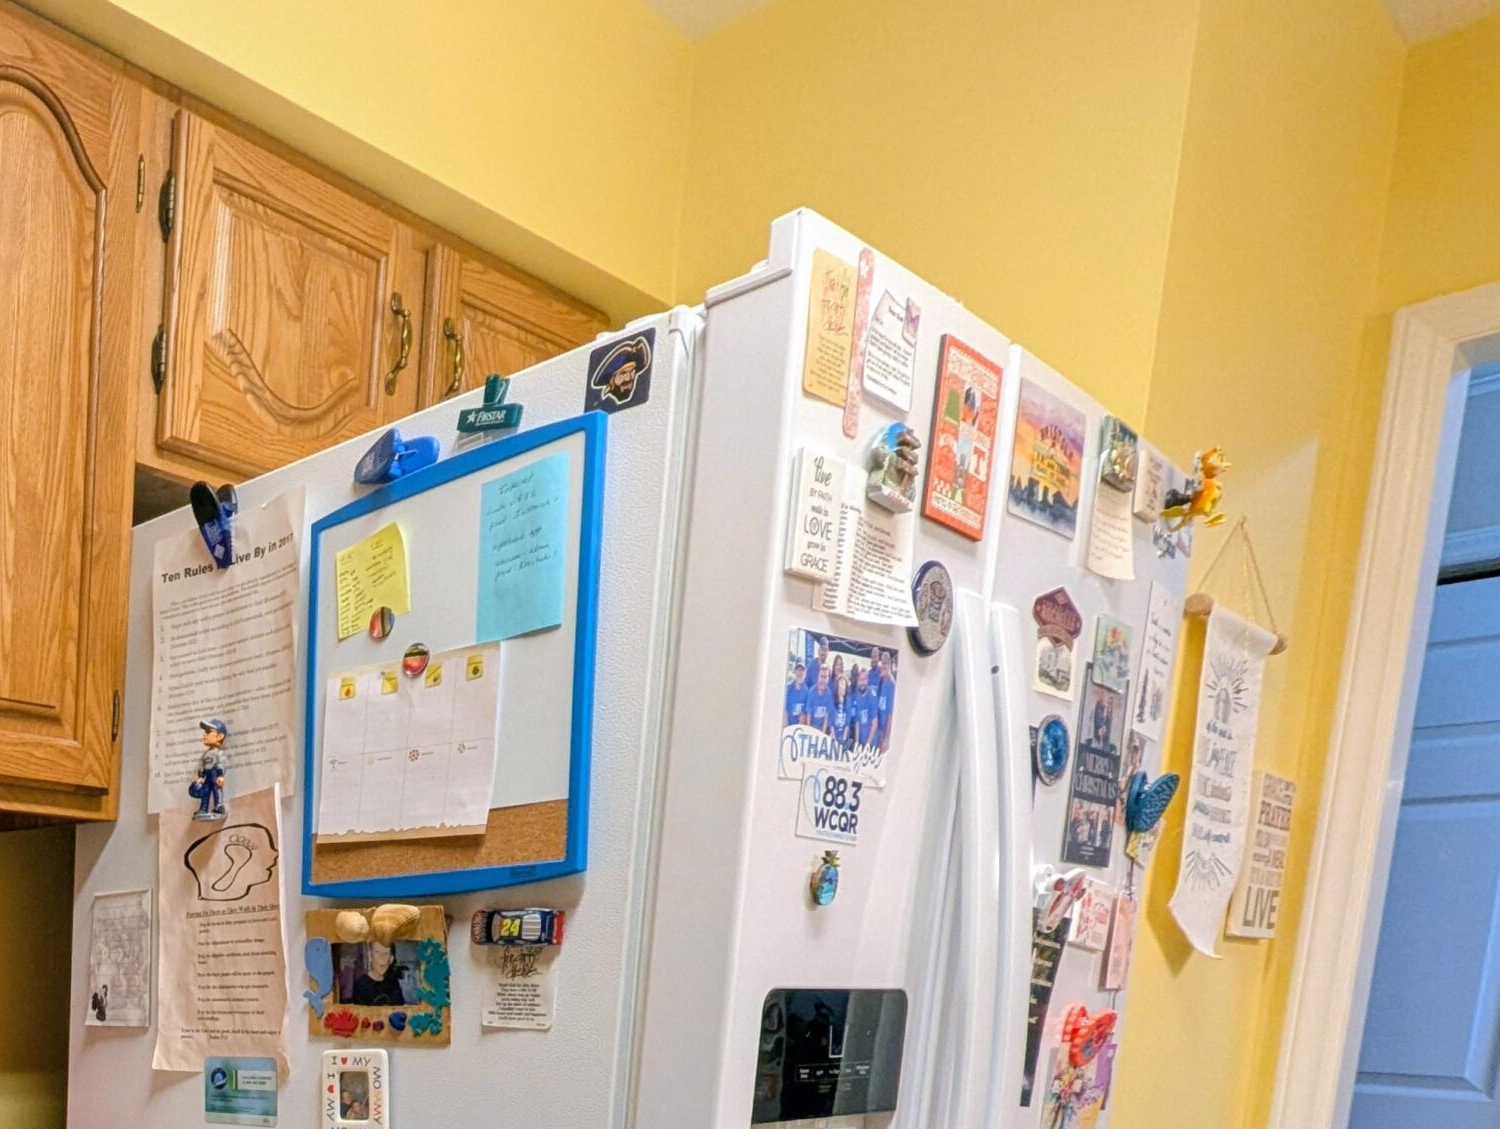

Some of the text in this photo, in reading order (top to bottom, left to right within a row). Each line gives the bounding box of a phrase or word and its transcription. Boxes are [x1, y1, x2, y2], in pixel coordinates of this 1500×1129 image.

[804, 514, 833, 541] LOVE
[161, 572, 181, 584] Ten
[184, 563, 214, 579] Rules
[254, 546, 265, 560] By
[268, 541, 277, 552] in
[278, 532, 294, 549] 2017
[800, 553, 829, 573] GRACE
[798, 733, 883, 775] THANK you
[822, 776, 863, 812] 88.3
[814, 805, 859, 835] WCQR
[1242, 885, 1280, 930] LIVE
[499, 918, 521, 937] 24
[331, 1056, 371, 1066] I MY
[326, 1098, 335, 1122] MY
[372, 1066, 382, 1125] MOMMY
